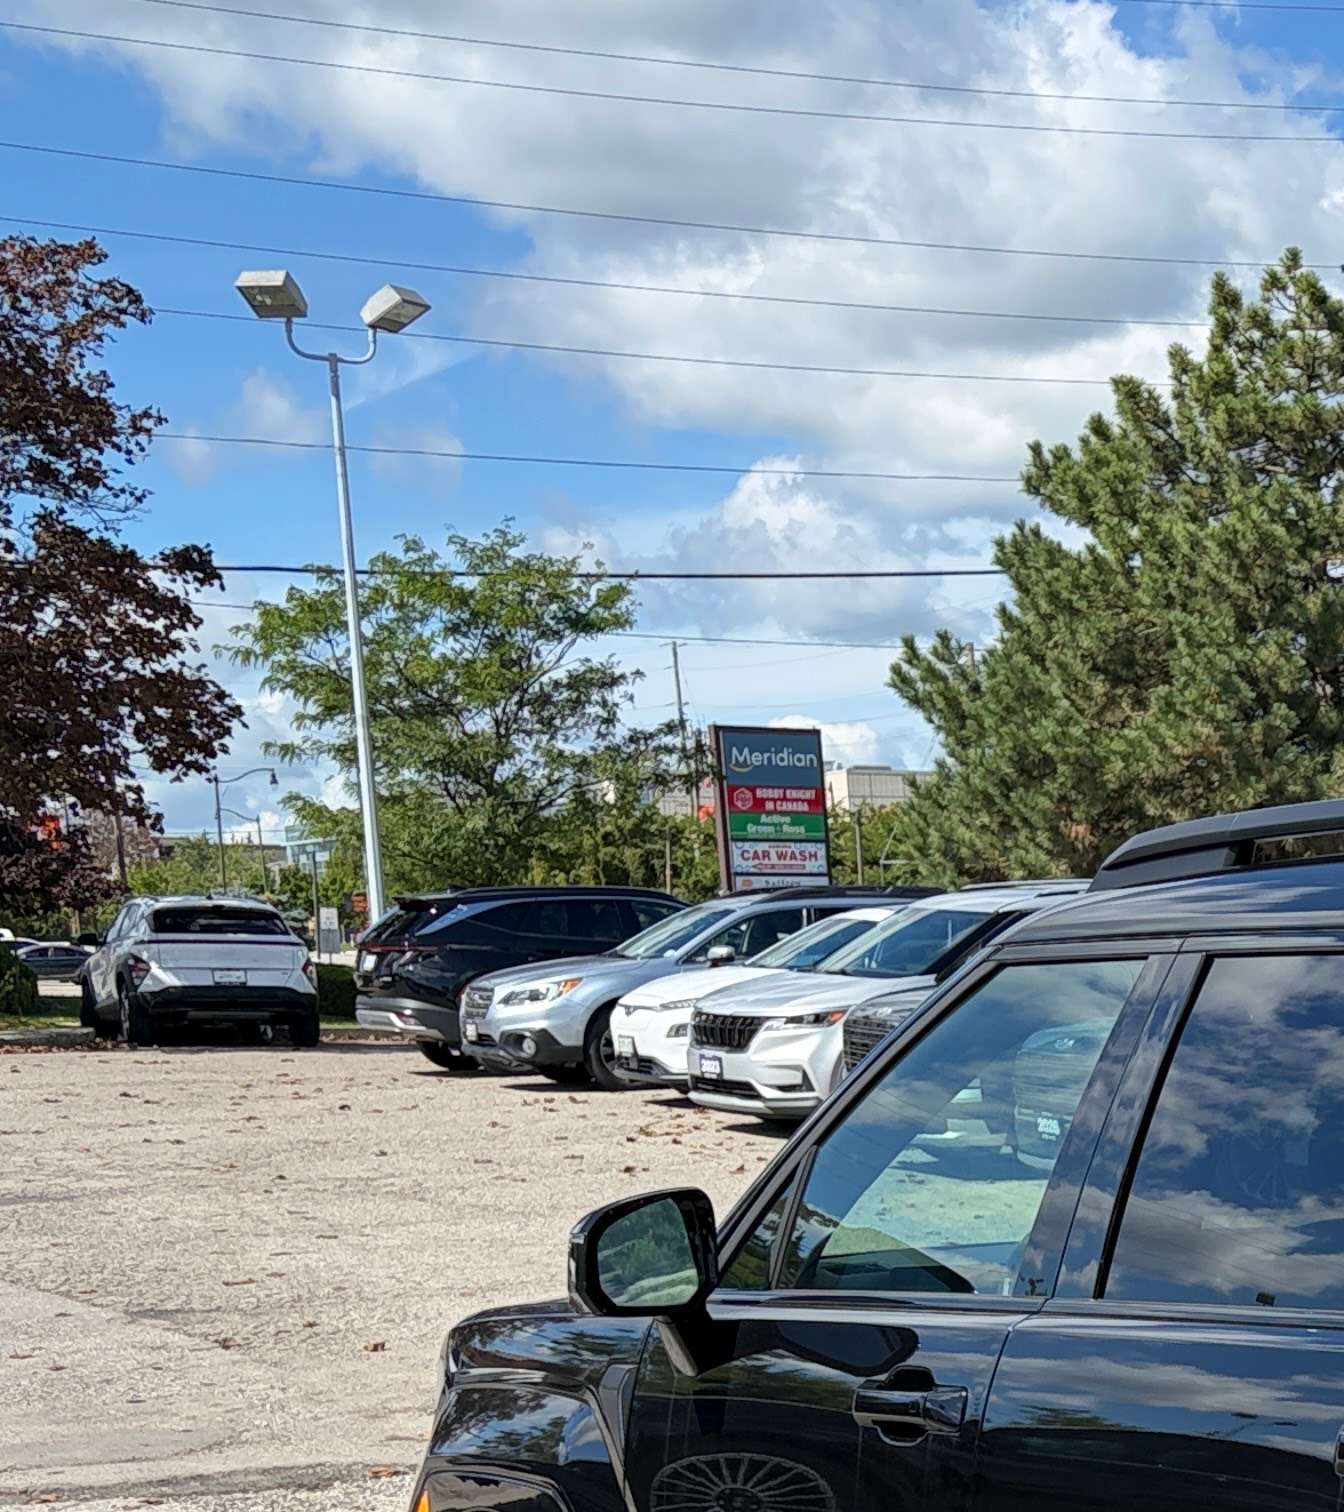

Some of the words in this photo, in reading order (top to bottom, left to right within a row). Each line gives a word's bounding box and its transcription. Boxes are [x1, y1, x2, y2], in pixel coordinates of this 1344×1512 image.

[731, 746, 818, 768] Meridian
[740, 849, 772, 862] CAR
[776, 849, 818, 862] WASH
